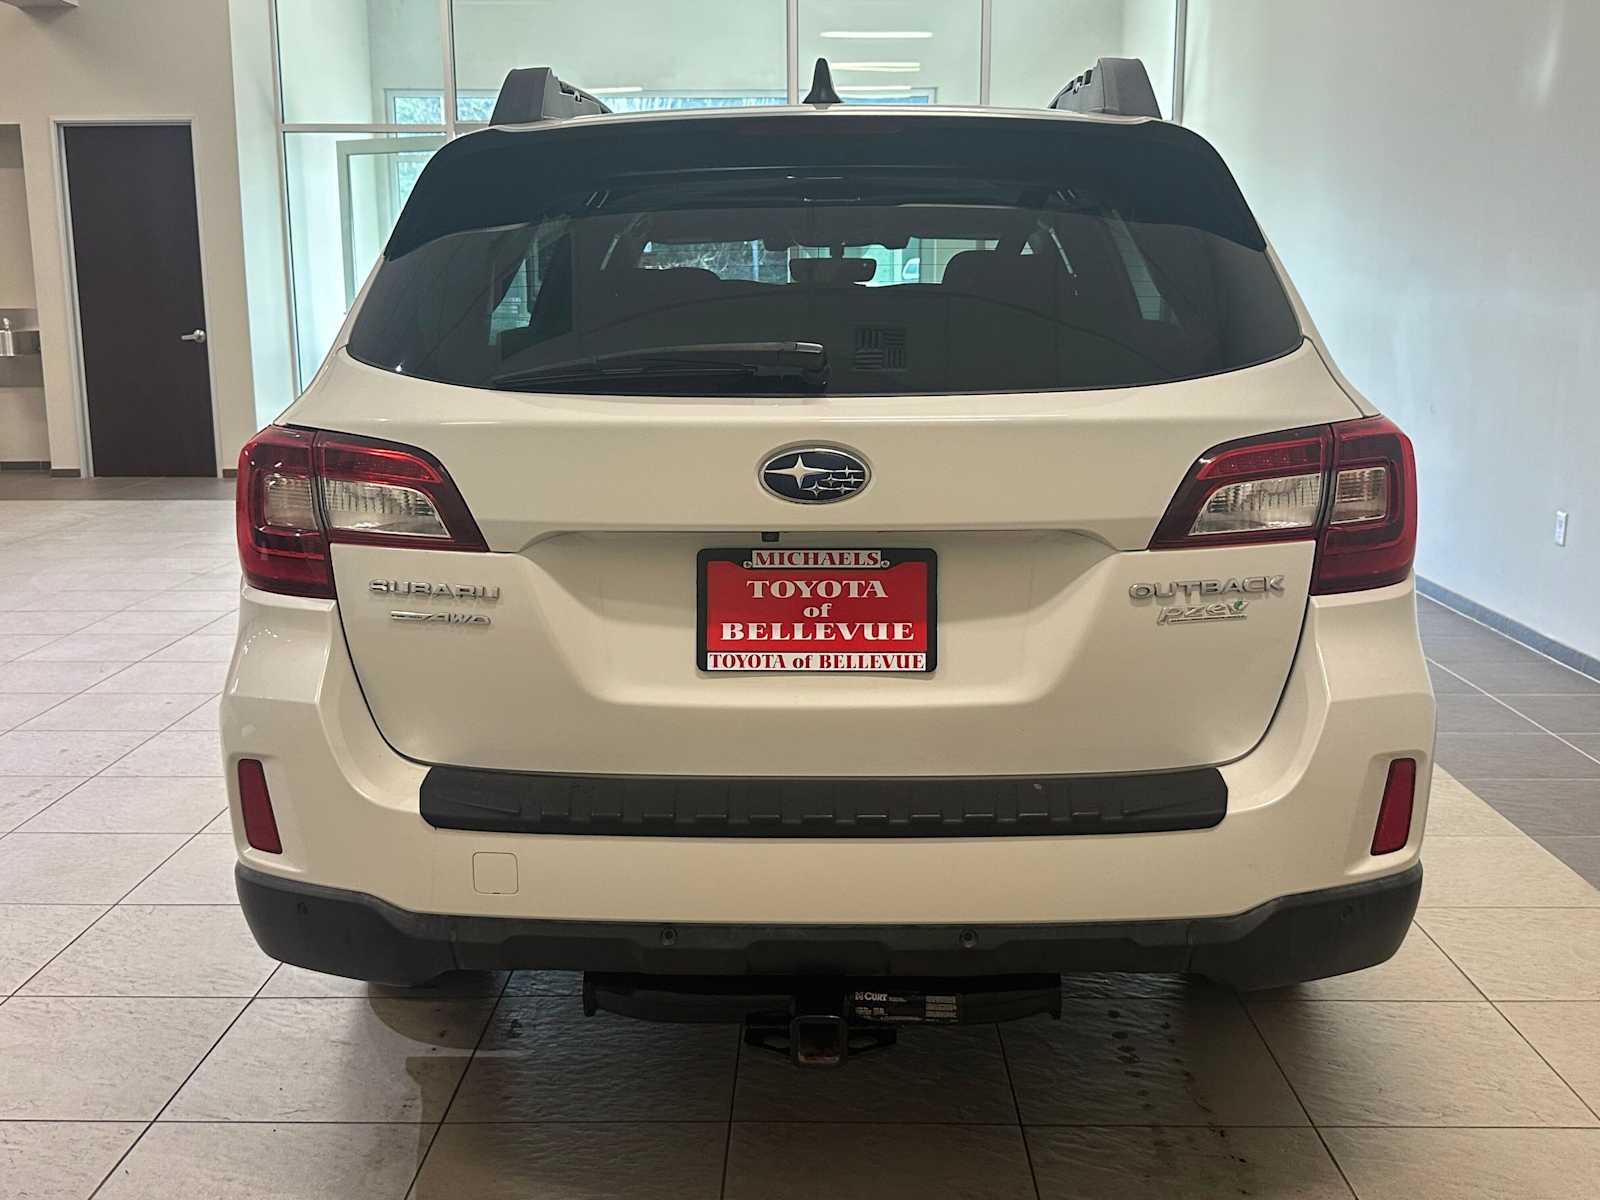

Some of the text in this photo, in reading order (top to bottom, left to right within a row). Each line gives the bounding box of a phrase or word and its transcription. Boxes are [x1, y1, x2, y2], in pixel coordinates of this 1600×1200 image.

[755, 552, 879, 566] MICHAELS
[368, 578, 500, 600] SUBARU
[746, 580, 888, 598] TOYOTA
[1128, 575, 1285, 600] OUTBACK
[426, 611, 492, 625] AWD
[803, 603, 832, 618] of
[720, 622, 914, 640] BELLEVUE
[709, 654, 924, 668] TOYOTA of BELLEVUE
